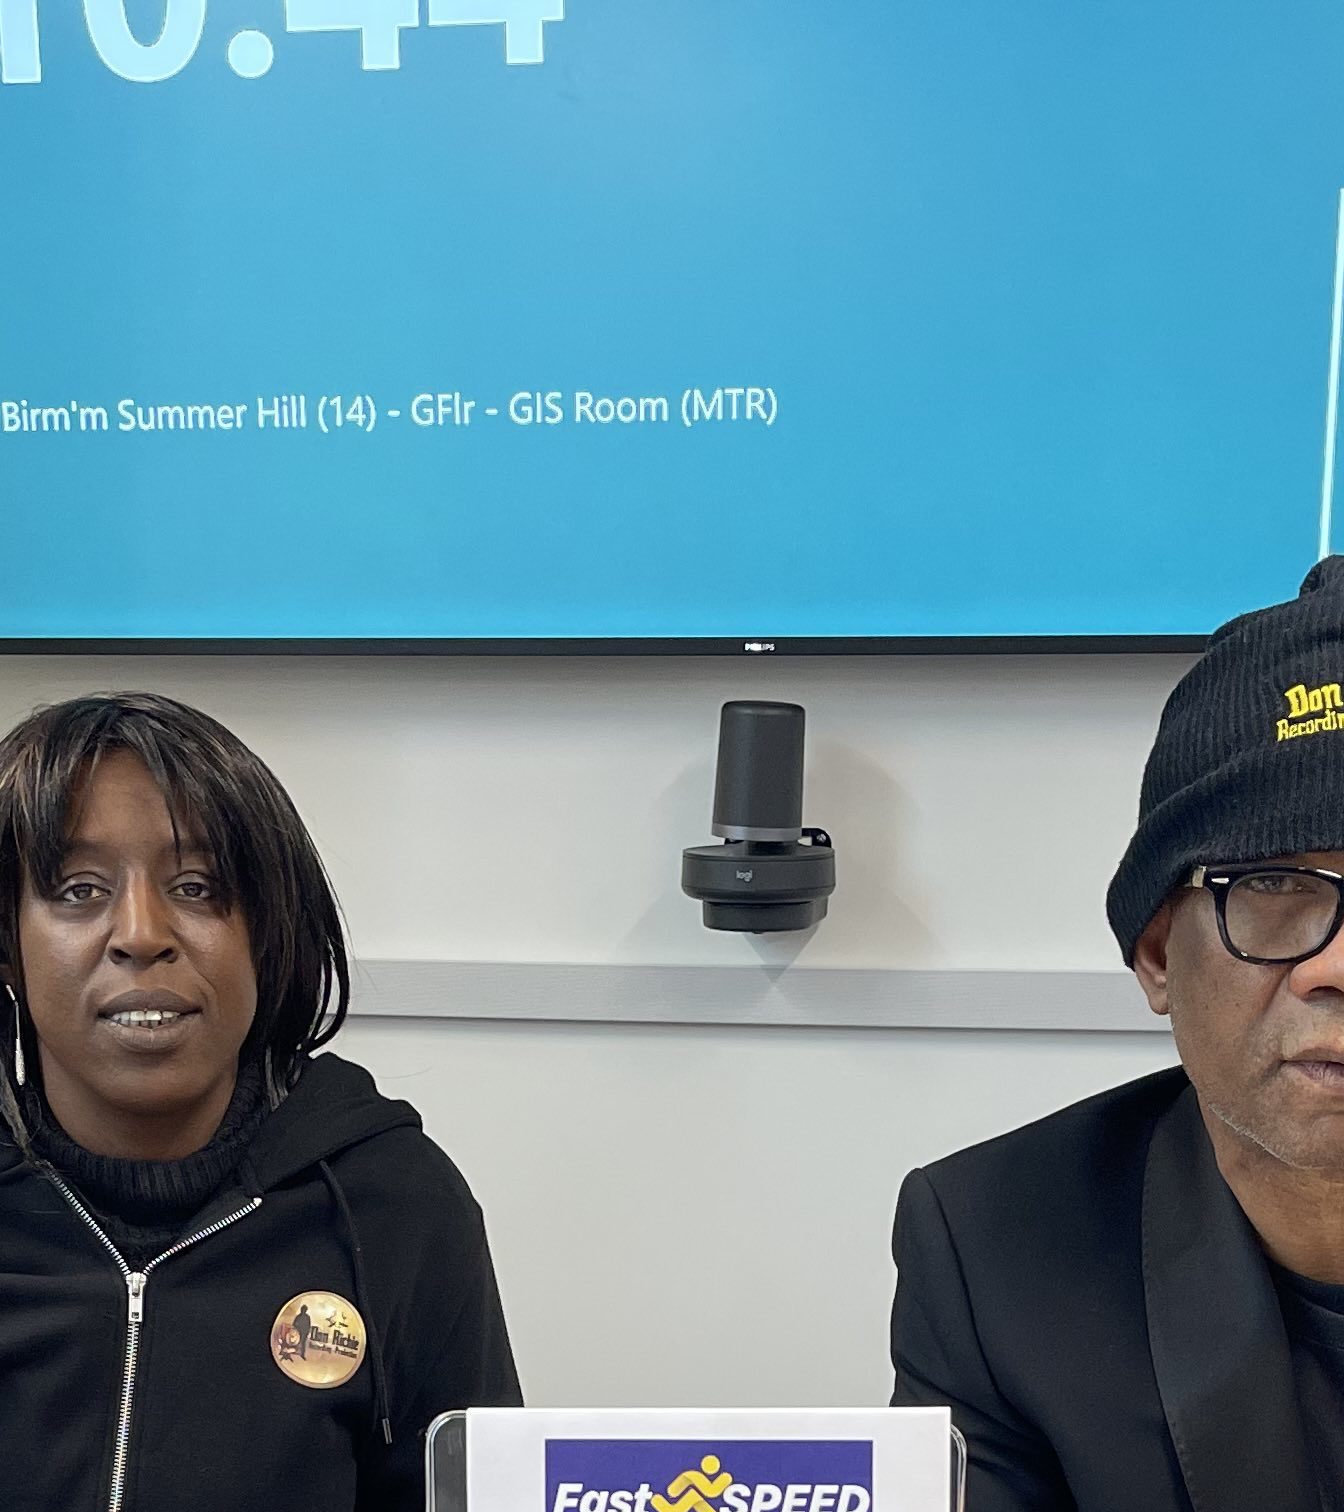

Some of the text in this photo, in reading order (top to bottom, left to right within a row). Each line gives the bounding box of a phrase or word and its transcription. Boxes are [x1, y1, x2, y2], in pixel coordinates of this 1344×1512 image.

[1, 397, 109, 434] Birm'm
[118, 397, 247, 432] Summer
[257, 395, 307, 431] Hill
[317, 394, 376, 434] (14)
[509, 393, 563, 426] GIS
[574, 392, 668, 425] Room
[680, 387, 778, 428] (MTR)
[1284, 681, 1344, 719] Don
[736, 869, 753, 882] logi
